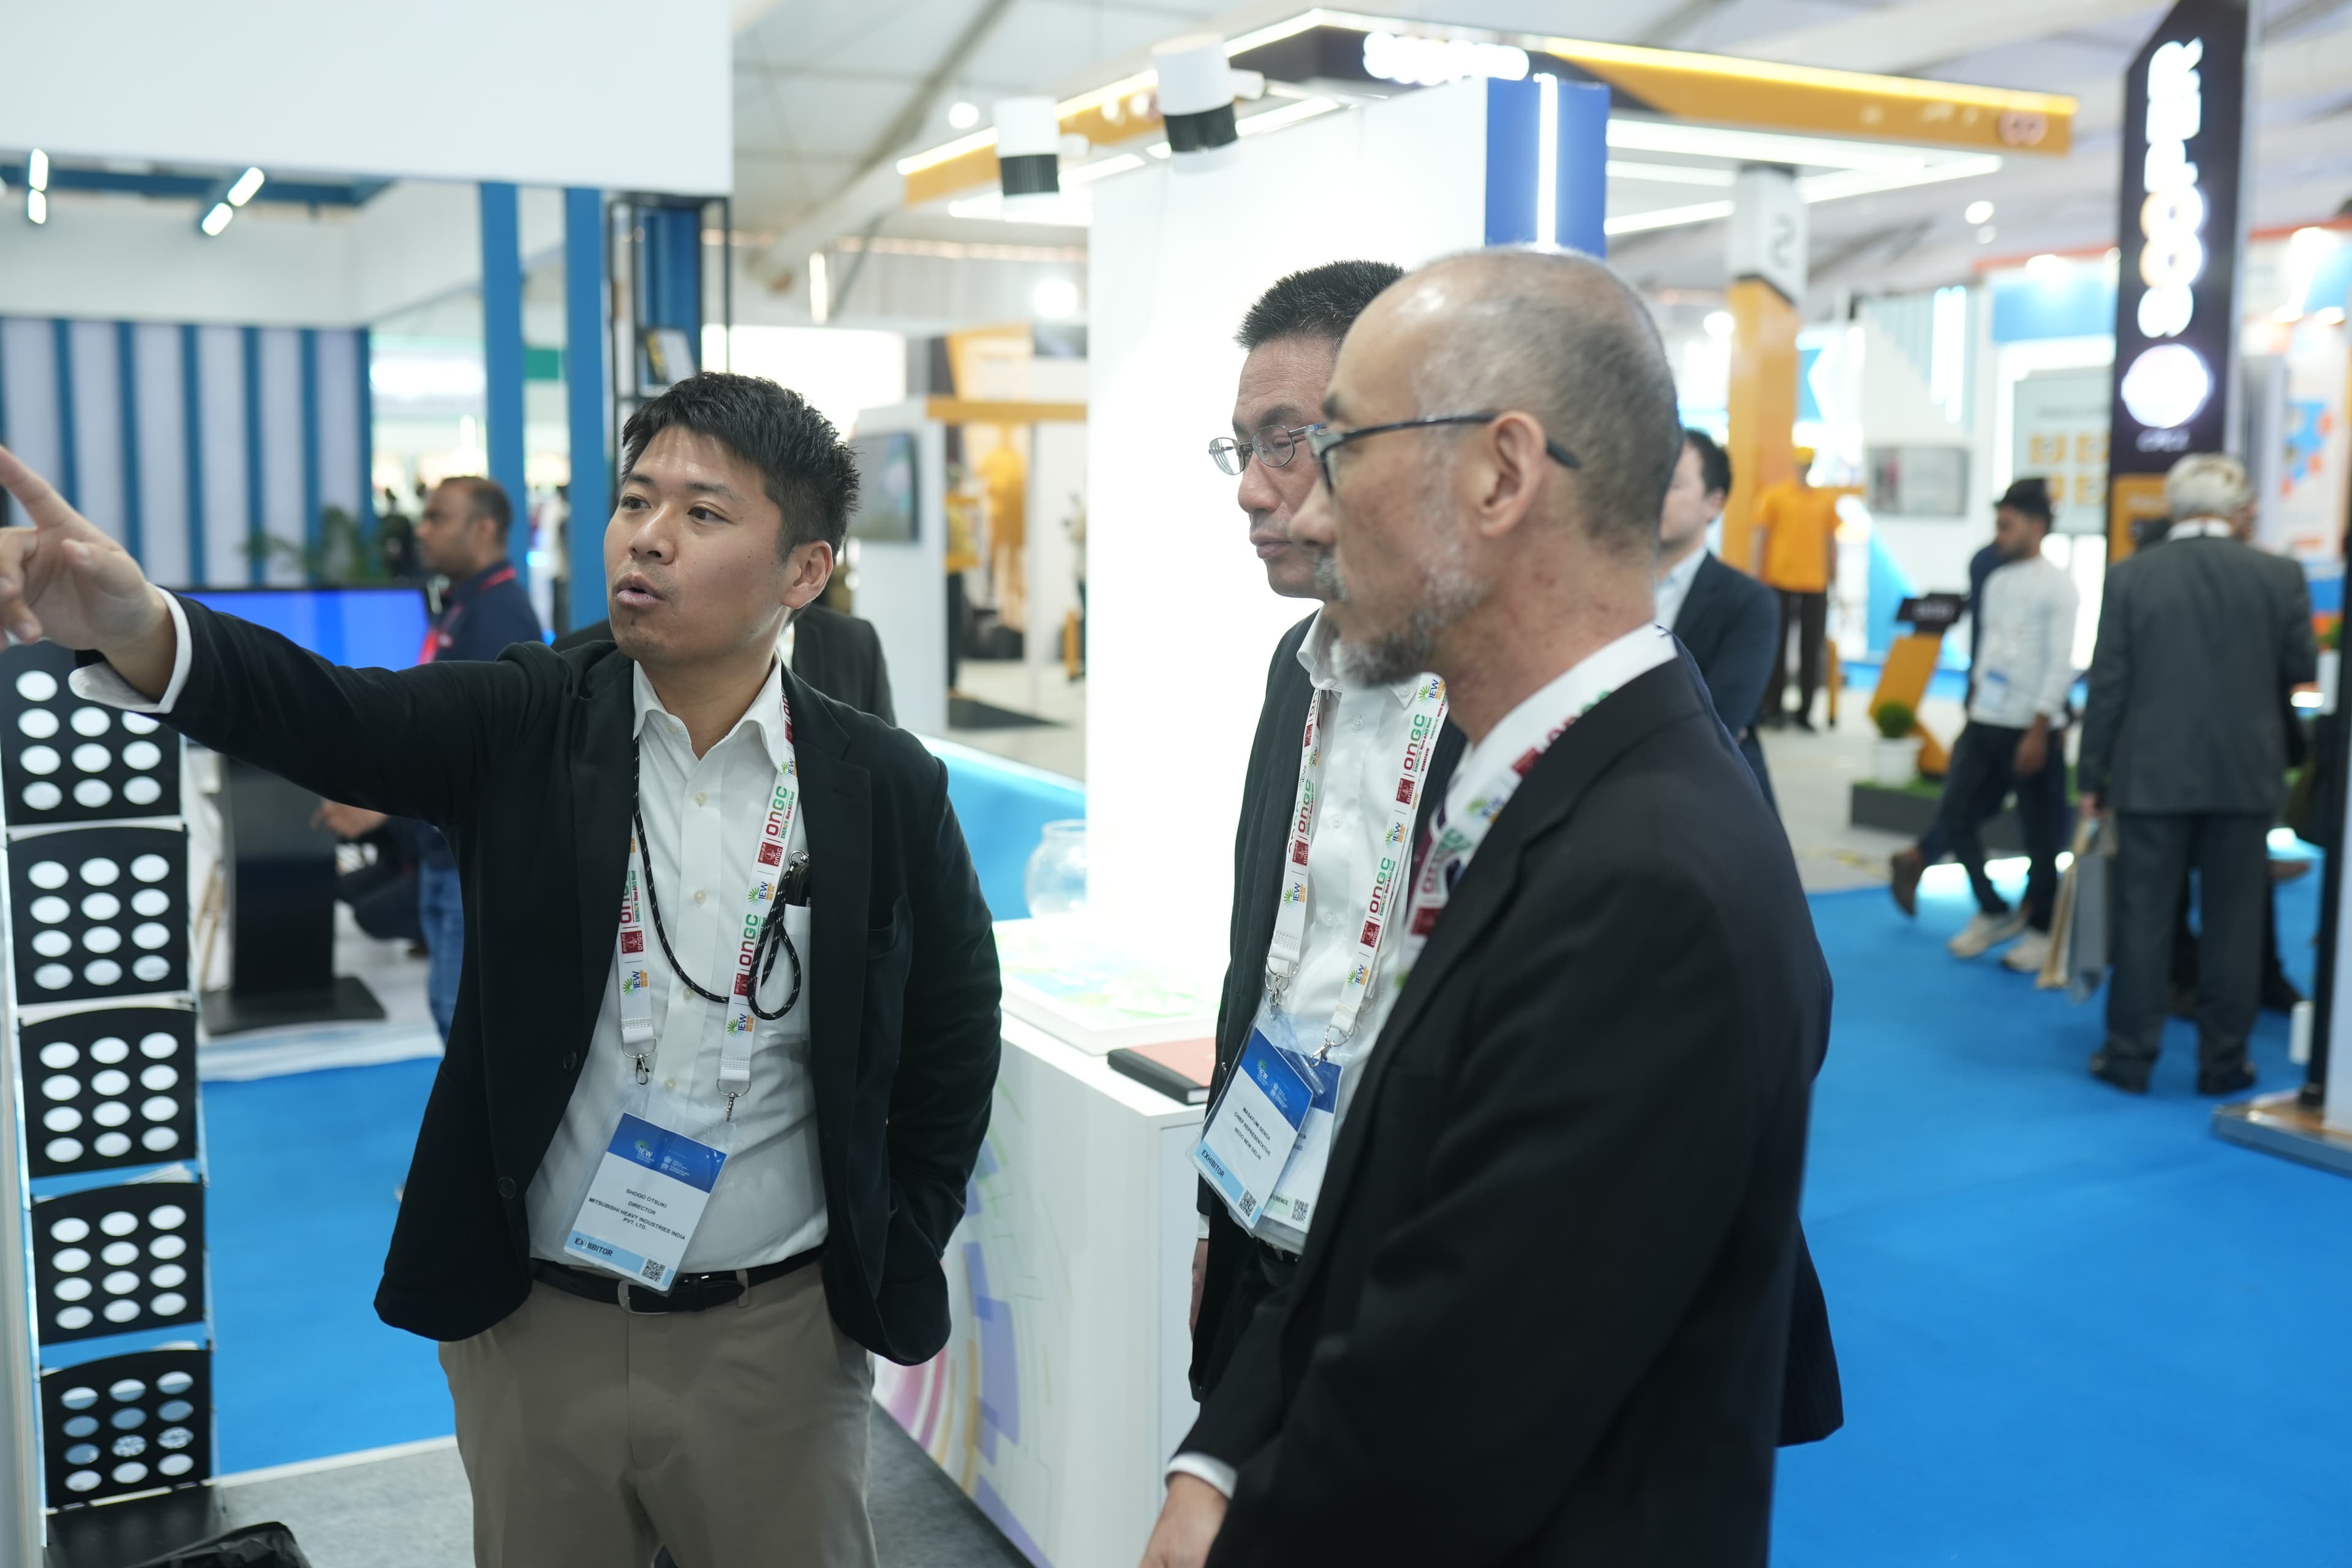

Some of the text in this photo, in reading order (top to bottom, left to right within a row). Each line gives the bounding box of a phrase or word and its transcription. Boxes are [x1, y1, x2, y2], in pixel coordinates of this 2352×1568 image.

[1428, 679, 1439, 698] IEW
[1404, 714, 1424, 770] ONGC
[1414, 751, 1423, 772] ENERGY:
[766, 786, 788, 835] ONGC
[1298, 780, 1311, 832] ONGC
[780, 820, 789, 839] ENERGY:
[1392, 822, 1401, 841] IEW
[758, 881, 768, 899] IEW
[1370, 858, 1390, 913] ONGC
[1379, 894, 1387, 916] ENERGY:
[739, 914, 758, 965] ONGC
[631, 970, 641, 988] IEW
[1354, 963, 1363, 983] IEW
[737, 1013, 747, 1031] IEW
[1234, 1112, 1270, 1156] CHIEF REPRESENTATIVE
[1243, 1107, 1270, 1141] MASAFUMI SENDA
[638, 1147, 653, 1158] IEW
[1234, 1127, 1244, 1139] NEDO
[1251, 1147, 1261, 1160] DELHI
[1202, 1150, 1224, 1178] EXHIBITOR
[625, 1188, 667, 1208] SHOGO OTSUKI
[628, 1201, 656, 1215] DIRECTOR
[589, 1197, 685, 1240] MITSUBISHI HEAVY INDUSTRIES INDIA
